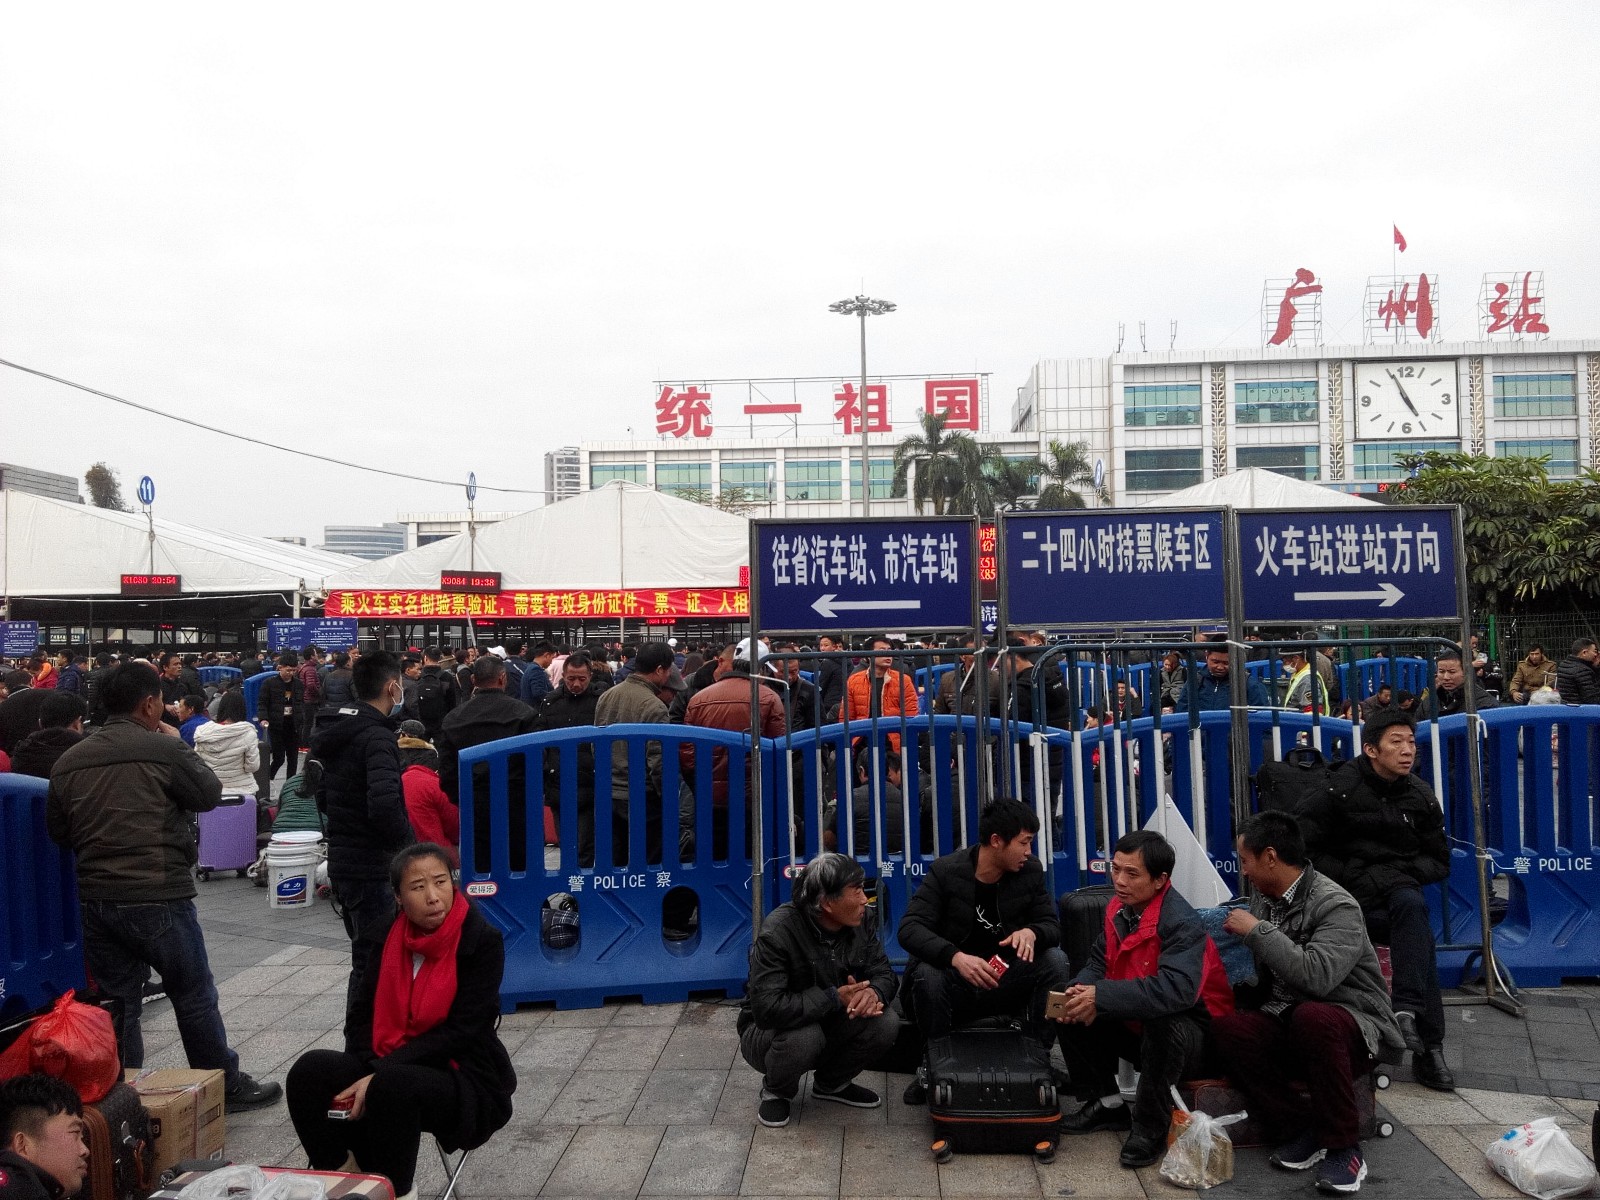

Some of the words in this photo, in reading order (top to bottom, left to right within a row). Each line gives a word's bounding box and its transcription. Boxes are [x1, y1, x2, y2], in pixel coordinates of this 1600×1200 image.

[1266, 267, 1550, 345] 广州站
[1396, 366, 1415, 378] 12
[655, 379, 979, 438] 统一祖国
[1361, 395, 1372, 408] 9
[1441, 393, 1452, 405] 3
[1401, 422, 1412, 434] 6
[1021, 522, 1212, 574] 二十四小时持票候车区
[1255, 522, 1441, 576] 火车站进站方向
[771, 532, 959, 587] 往省汽车站、市汽车站
[1514, 856, 1531, 874] 警
[1539, 857, 1593, 872] POLICE
[568, 875, 585, 892] 警
[593, 874, 646, 890] POLICE
[656, 871, 671, 888] 察
